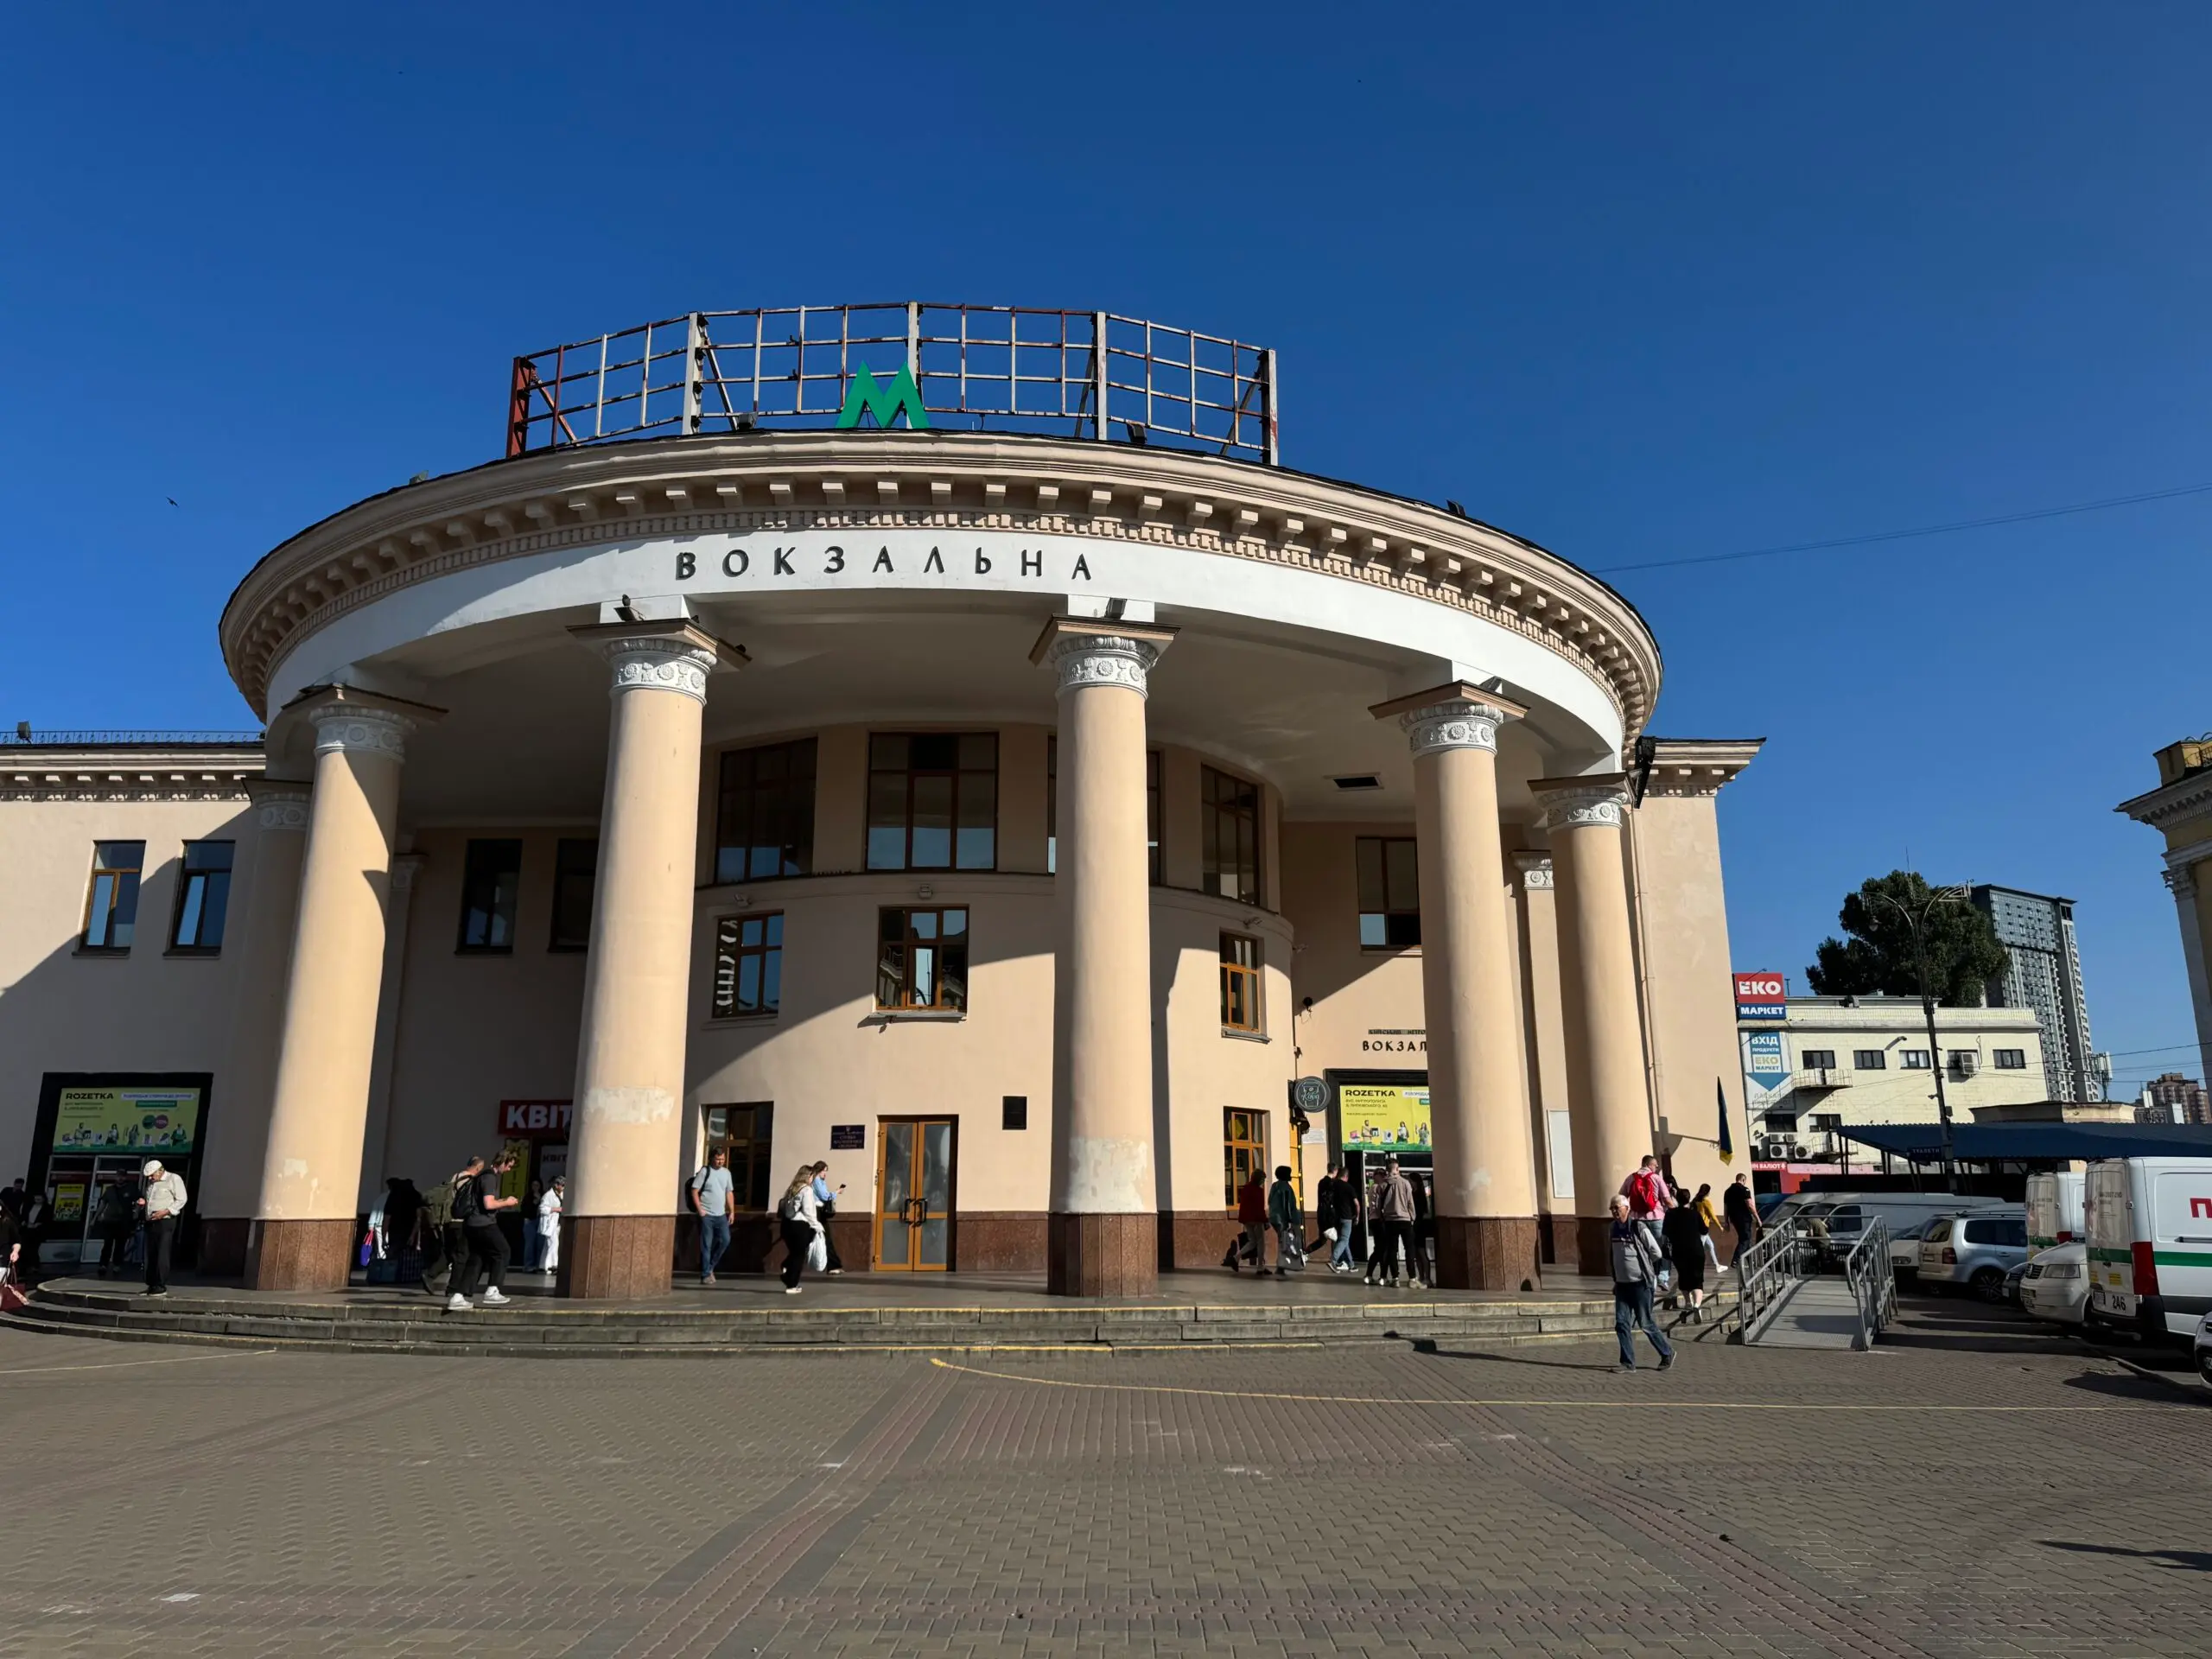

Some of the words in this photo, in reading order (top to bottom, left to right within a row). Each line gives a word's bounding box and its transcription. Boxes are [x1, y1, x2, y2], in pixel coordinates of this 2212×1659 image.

[675, 545, 1091, 581] ВОКЗАЛЬНА
[1738, 981, 1781, 995] ЕКО
[1740, 1007, 1784, 1015] МАРКЕТ
[1363, 1040, 1427, 1052] ВОКЗАЛ
[1751, 1036, 1778, 1046] ВХІД
[1755, 1056, 1779, 1065] ЕКО
[2112, 1294, 2126, 1311] 246
